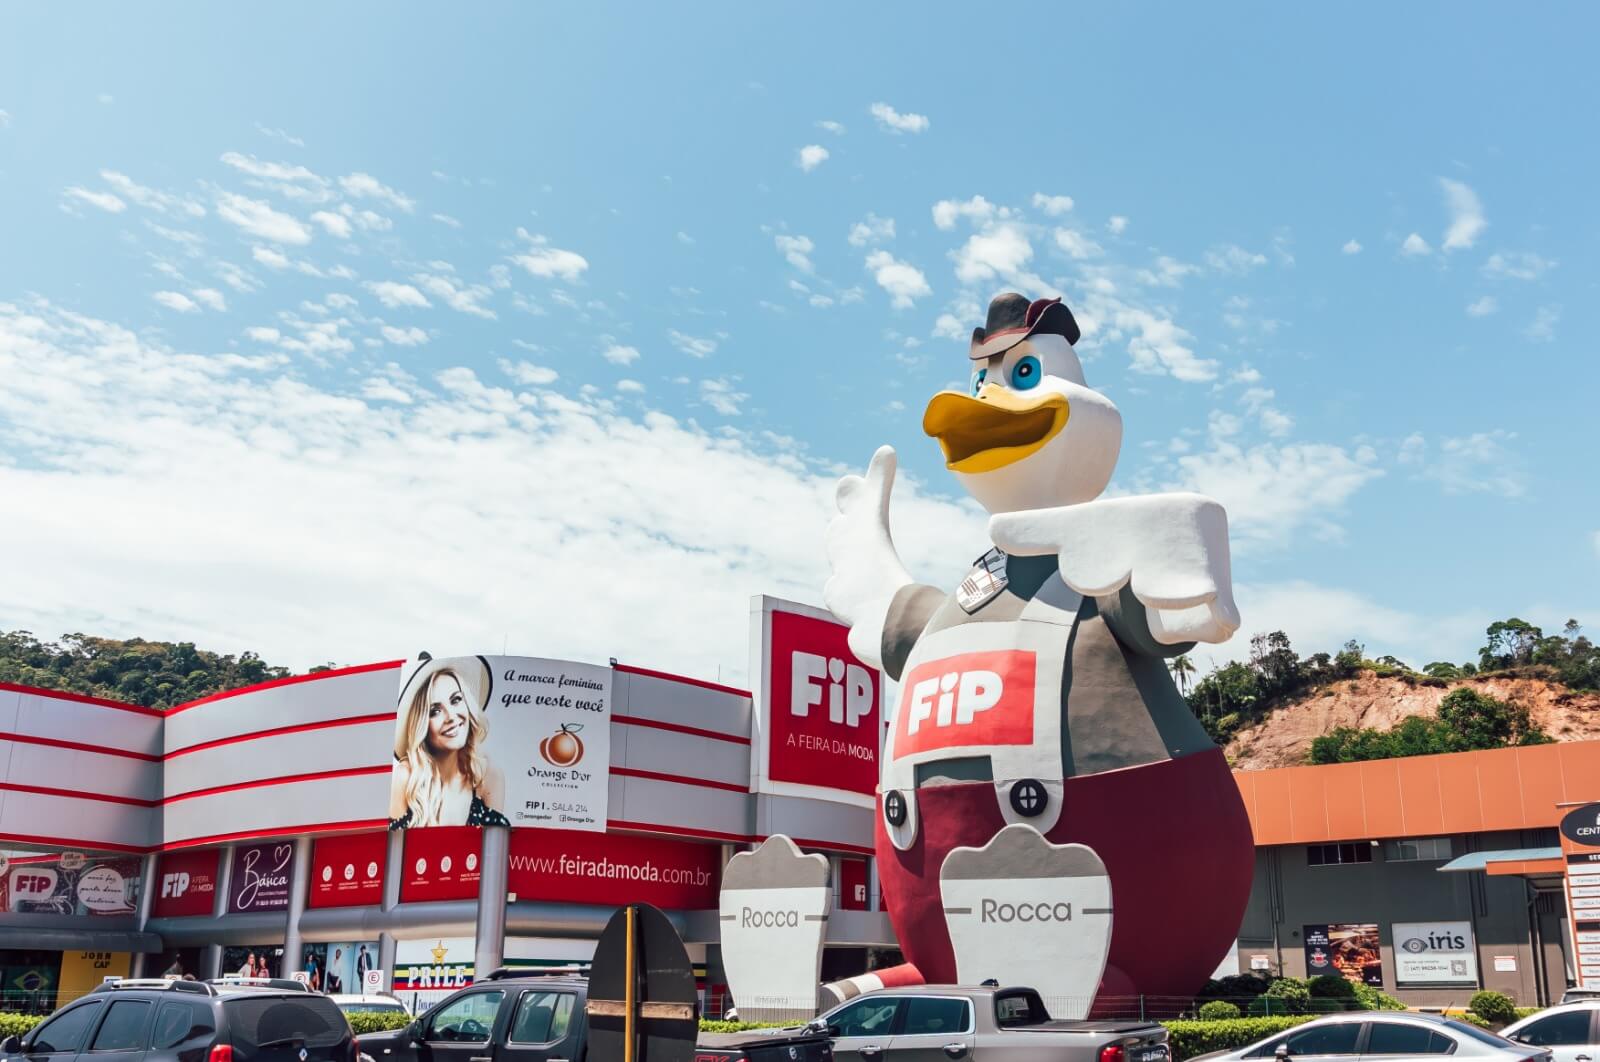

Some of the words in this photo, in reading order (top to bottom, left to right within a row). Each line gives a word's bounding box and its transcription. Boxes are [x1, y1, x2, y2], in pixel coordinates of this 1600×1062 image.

[504, 669, 515, 681] A
[518, 674, 555, 684] marca
[558, 674, 604, 691] feminina
[502, 693, 531, 708] que
[536, 695, 572, 708] veste
[575, 699, 604, 712] você
[787, 733, 795, 747] A
[799, 735, 830, 752] FEIRA
[833, 740, 847, 755] DA
[848, 744, 874, 762] MODA
[527, 766, 567, 781] Orange
[526, 801, 540, 810] FIP
[552, 802, 574, 811] SALA
[575, 804, 588, 813] 214
[237, 849, 288, 909] Básica
[509, 853, 711, 887] www.feiradamoda.com.br
[742, 905, 799, 928] Rocca
[981, 898, 1072, 923] Rocca
[407, 965, 466, 988] PRILE
